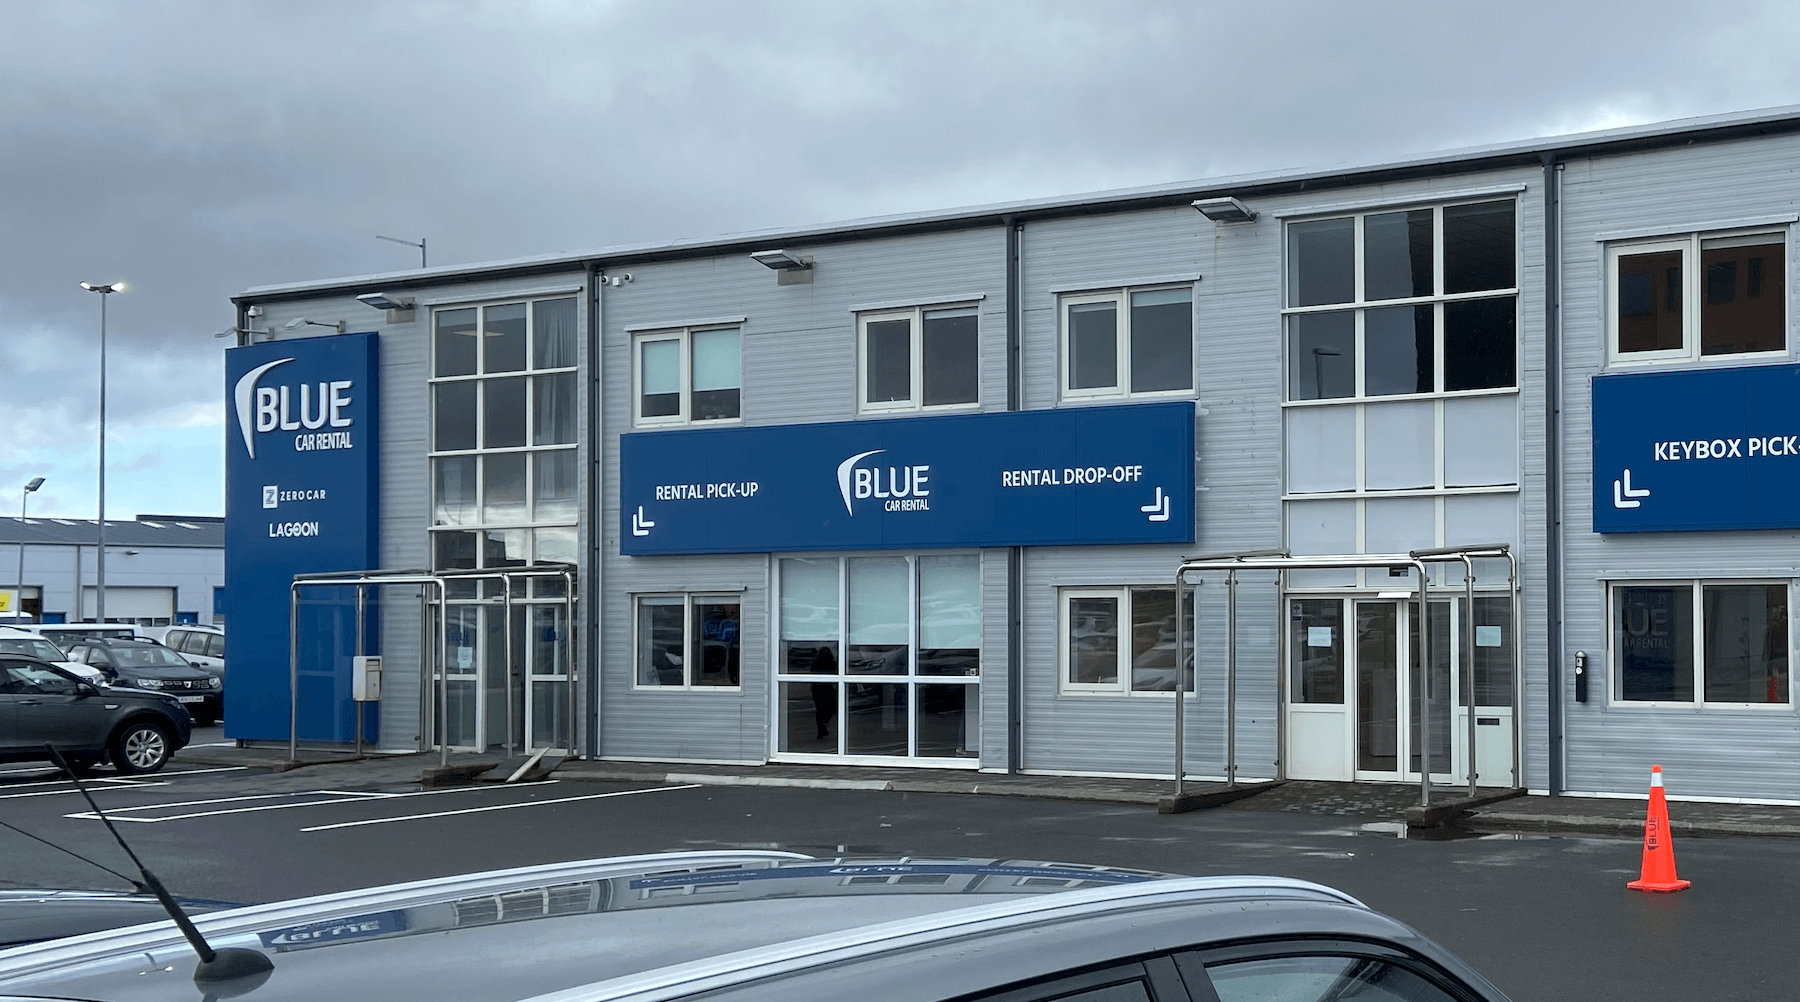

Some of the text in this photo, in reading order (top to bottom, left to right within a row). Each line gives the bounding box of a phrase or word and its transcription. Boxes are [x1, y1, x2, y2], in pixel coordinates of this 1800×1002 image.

[257, 381, 353, 432] BLUE
[295, 432, 353, 451] CAR RENTAL
[1655, 438, 1742, 461] KEYBOX
[855, 465, 930, 499] BLUE
[1002, 465, 1142, 487] RENTAL DROP-OFF
[656, 482, 759, 500] RENTAL PICK-UP
[885, 499, 930, 512] CAR RENTAL
[269, 522, 319, 537] LAGOON
[1627, 608, 1669, 636] UE
[1636, 637, 1669, 649] RENTAL
[1649, 816, 1657, 846] BLUE
